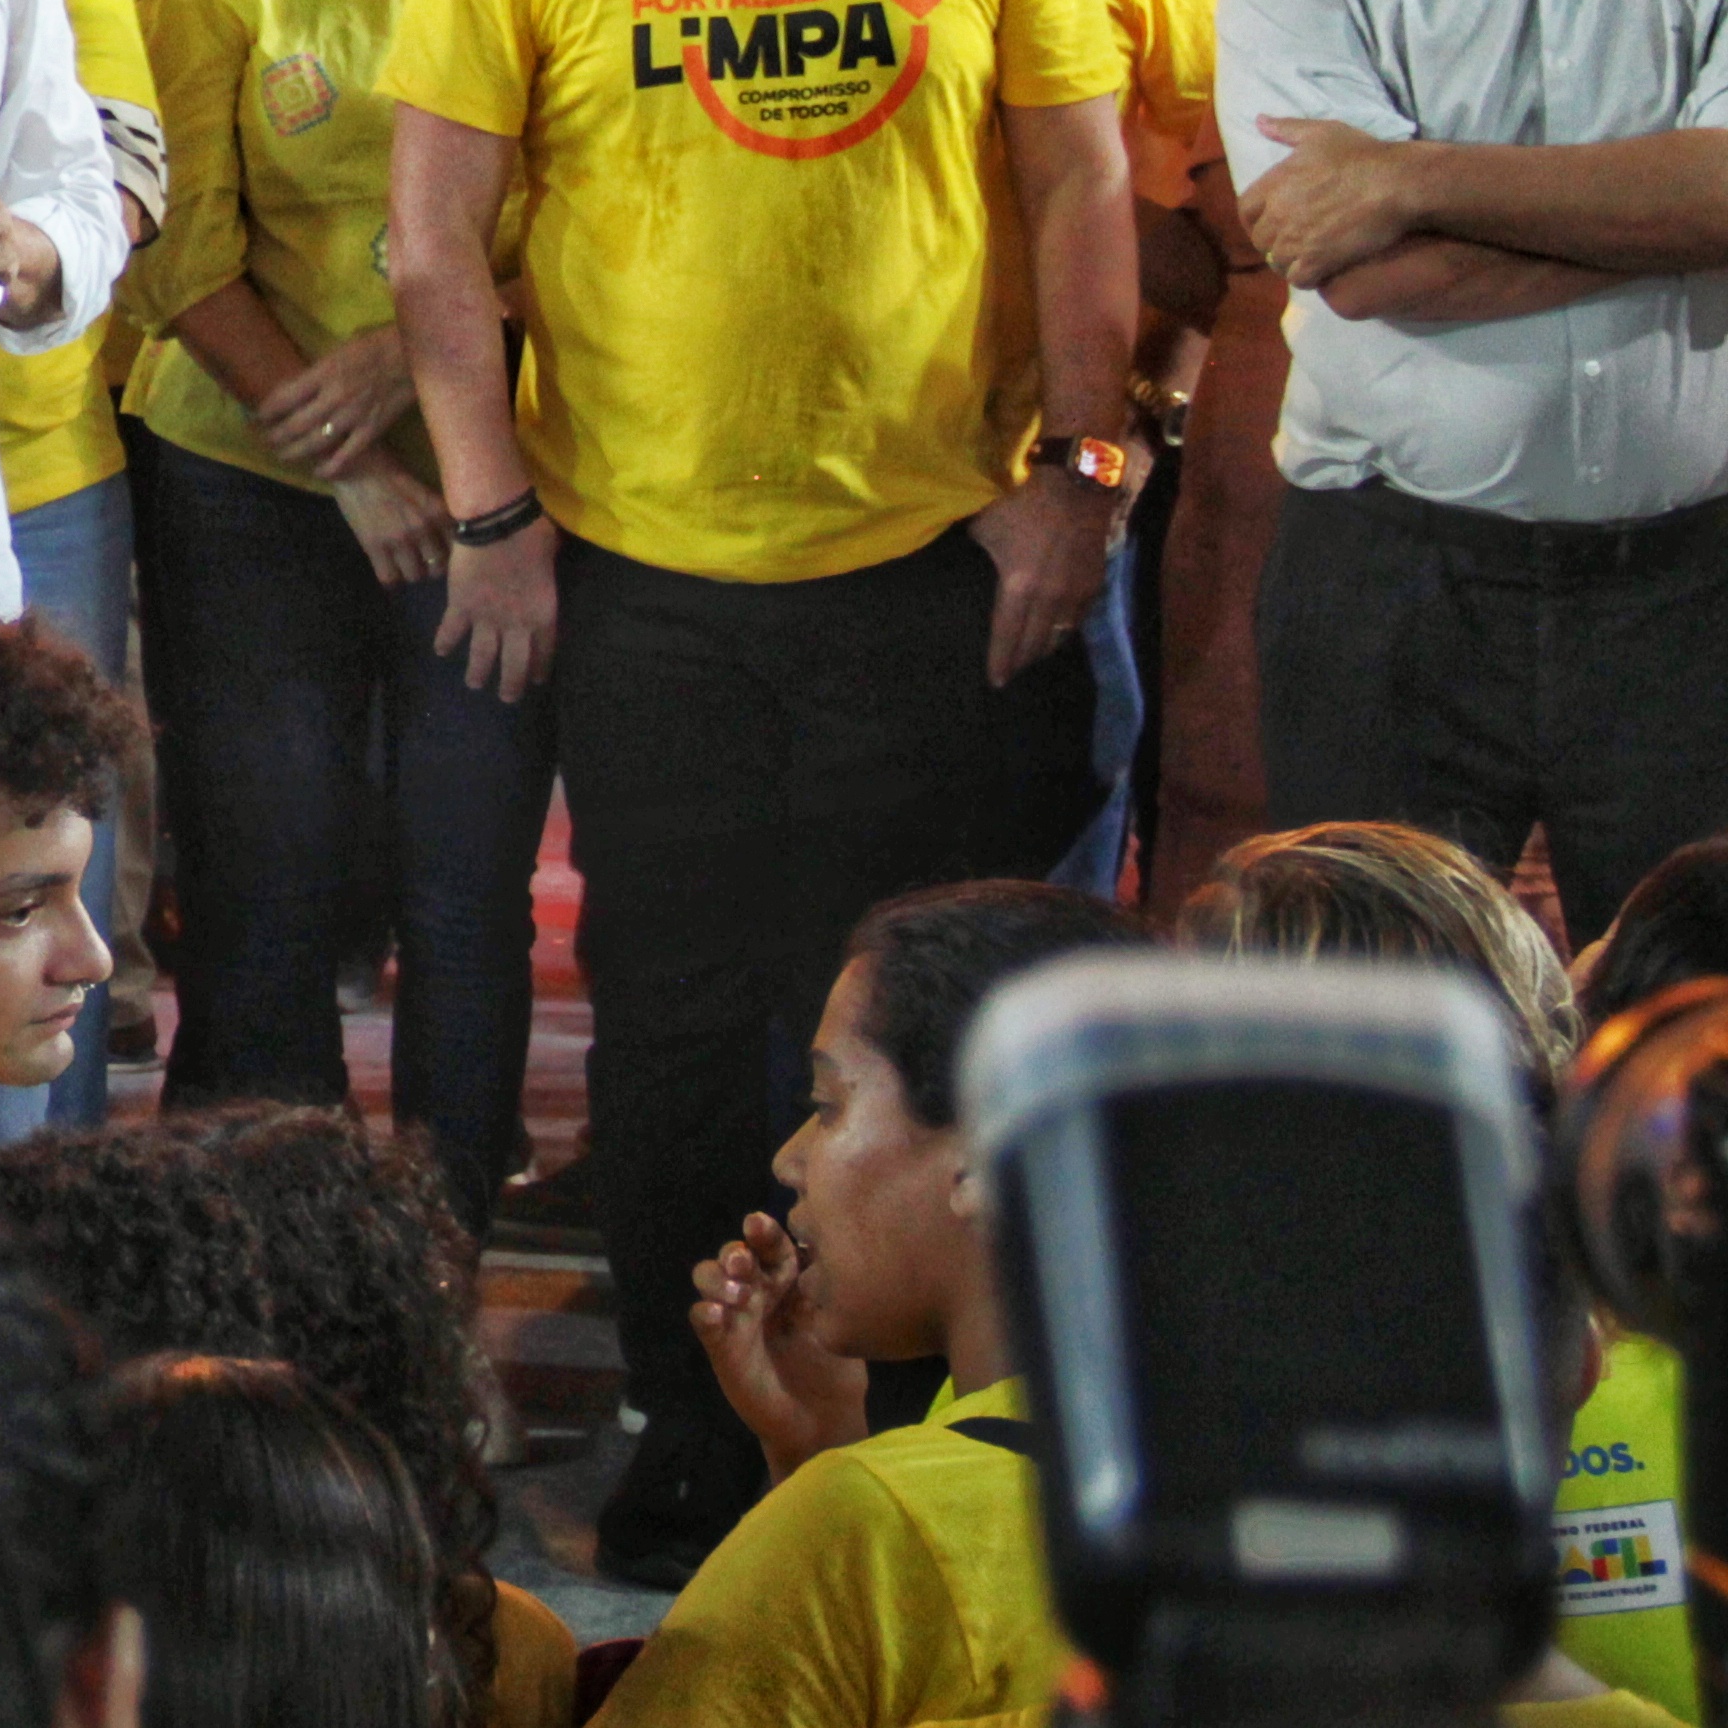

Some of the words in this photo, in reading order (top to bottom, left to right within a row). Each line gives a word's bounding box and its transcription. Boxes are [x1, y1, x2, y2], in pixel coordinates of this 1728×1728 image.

[738, 79, 871, 106] COMPROMISSO
[759, 108, 784, 122] DE
[788, 101, 849, 121] TODOS
